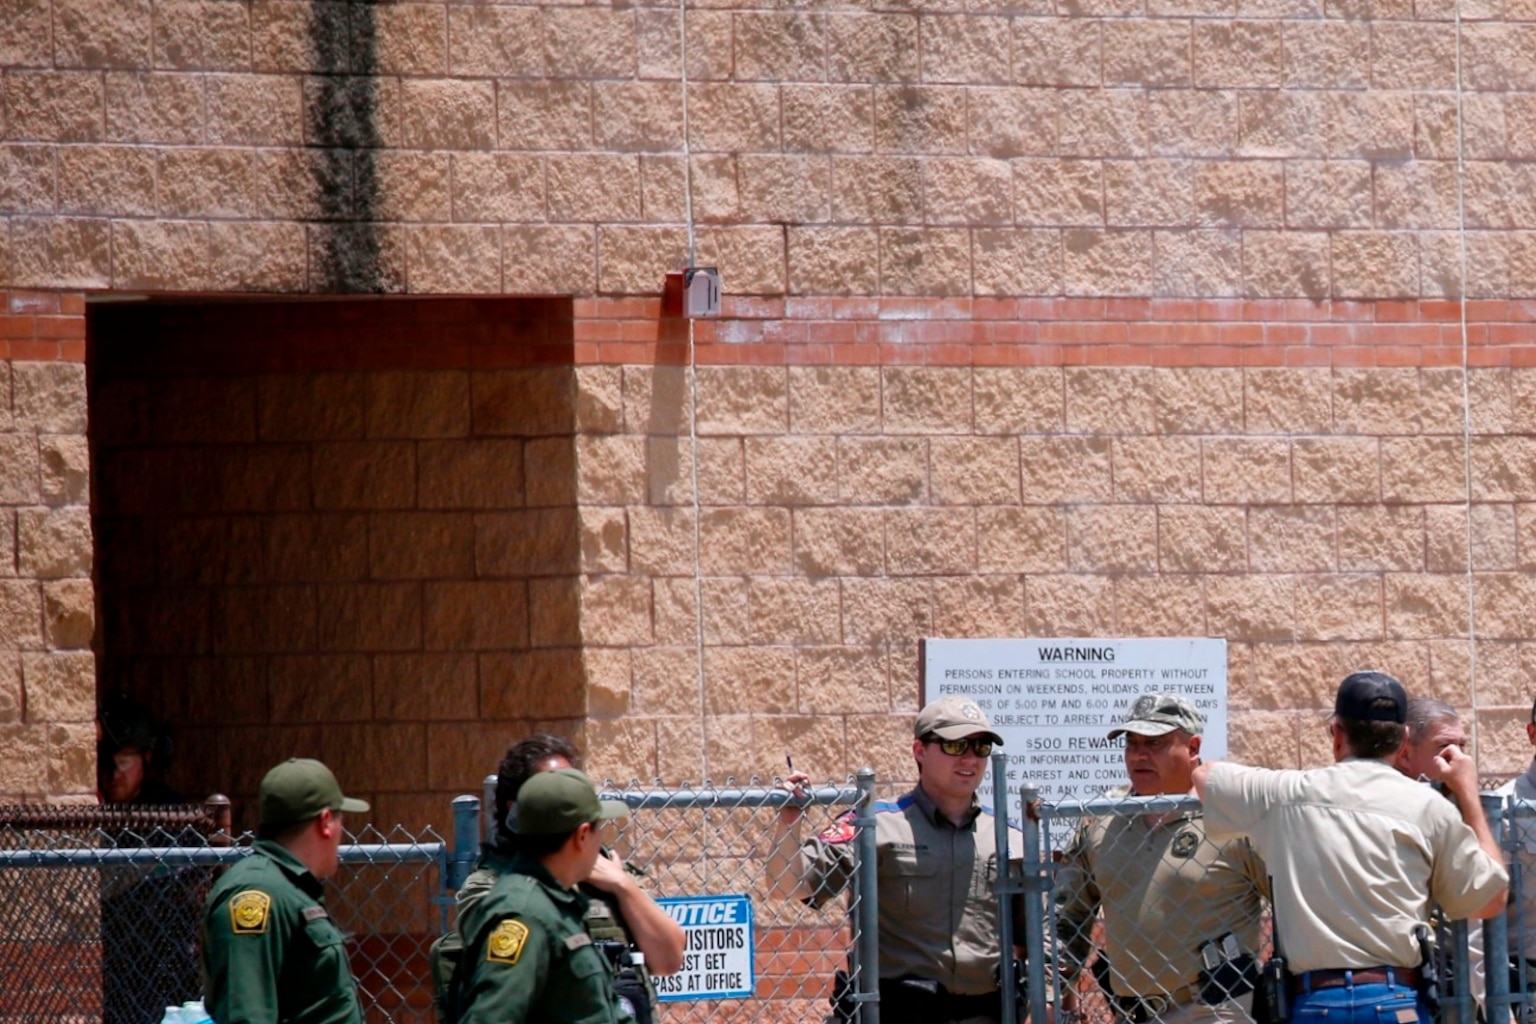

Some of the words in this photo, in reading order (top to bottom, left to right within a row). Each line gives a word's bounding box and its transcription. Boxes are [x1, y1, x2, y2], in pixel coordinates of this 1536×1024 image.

[1038, 646, 1115, 661] WARNING
[945, 668, 993, 680] PERSONS
[998, 668, 1050, 680] ENTERING
[1055, 668, 1097, 680] SCHOOL
[1101, 668, 1155, 680] PROPERTY
[1161, 668, 1208, 679] WITHOUT
[939, 684, 1002, 695] PERMISSION
[1006, 684, 1022, 694] ON
[1091, 684, 1140, 694] HOLIDAYS
[1144, 684, 1158, 693] OR
[1163, 684, 1214, 694] BETWEEN
[997, 699, 1010, 710] OF
[1041, 699, 1057, 710] PM
[1061, 699, 1082, 709] AND
[1113, 699, 1128, 709] AM
[993, 714, 1039, 725] SUBJECT
[1044, 714, 1059, 725] TO
[1063, 714, 1104, 725] ARREST
[1030, 754, 1100, 764] INFORMATION
[1022, 769, 1062, 780] ARREST
[1068, 769, 1090, 780] AND
[1057, 785, 1078, 794] ANY
[704, 953, 727, 970] GET
[653, 975, 683, 993] PASS
[687, 974, 702, 992] AT
[705, 972, 743, 991] OFFICE
